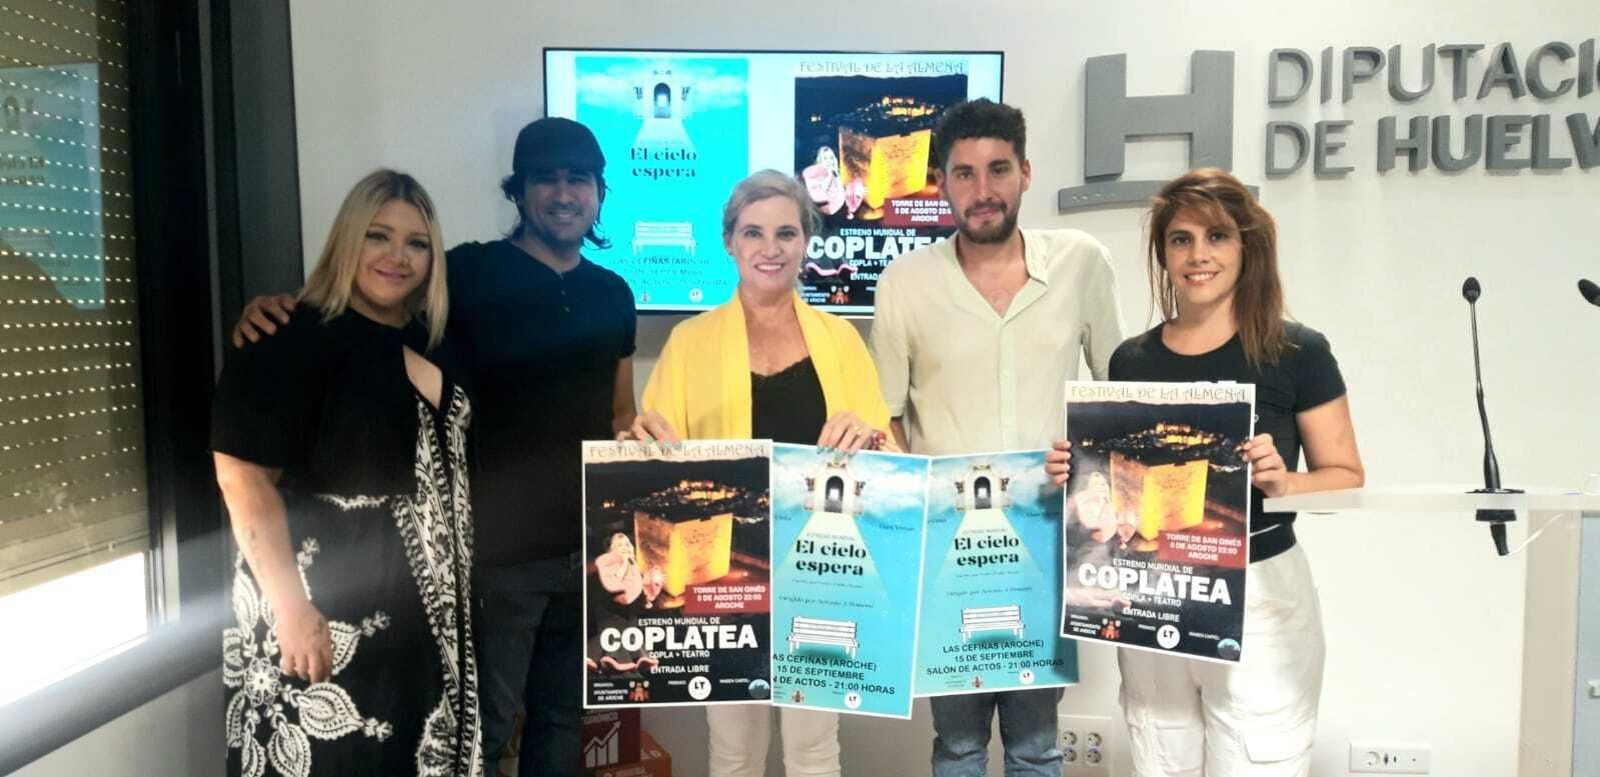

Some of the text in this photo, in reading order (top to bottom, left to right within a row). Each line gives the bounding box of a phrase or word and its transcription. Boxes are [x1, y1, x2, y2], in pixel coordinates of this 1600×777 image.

[800, 60, 860, 74] FESTIVAL
[907, 60, 965, 75] ALMENA
[1268, 38, 1600, 107] DIPUTACI
[630, 147, 698, 161] El cielo
[1265, 119, 1355, 180] DE
[632, 166, 697, 181] espera
[840, 228, 916, 237] ESTRENO MUNDIAL DE
[1072, 386, 1246, 400] FESTIVAL DE LA ALMENA
[954, 535, 1019, 551] El cielo
[1166, 533, 1190, 543] TORRE
[1191, 535, 1202, 543] DE
[1202, 536, 1218, 545] SAN
[1176, 542, 1186, 550] DE
[795, 539, 867, 559] El cielo
[957, 552, 1019, 568] espera
[1113, 558, 1193, 574] ESTRENO MUNDIAL DE
[795, 560, 864, 576] espera
[693, 586, 717, 594] TORRE
[1078, 563, 1232, 605] COPLATEA
[1154, 596, 1182, 607] TEATRO
[638, 617, 720, 627] ESTRENO MUNDIAL DE
[1122, 607, 1180, 622] ENTRADA LIBRE
[600, 624, 758, 652] COPLATEA
[1162, 630, 1174, 639] LT
[649, 651, 674, 659] COPLA
[682, 649, 710, 658] TEATRO
[943, 639, 1045, 654] LAS CEFIÑAS (AROCHE)
[773, 654, 877, 671] AS CEFIÑAS (AROCHE)
[954, 650, 1034, 663] 15 DE SEPTIEMBRE
[651, 664, 710, 674] ENTRADA LIBRE
[777, 665, 865, 681] 15 DE SEPTIEMBRE
[926, 665, 957, 676] SALÓN
[958, 664, 970, 673] DE
[972, 663, 1001, 672] ACTOS
[1033, 658, 1065, 668] HORAS
[694, 681, 705, 690] LT
[779, 676, 792, 685] DE
[795, 678, 827, 688] ACTOS
[861, 684, 896, 695] HORAS
